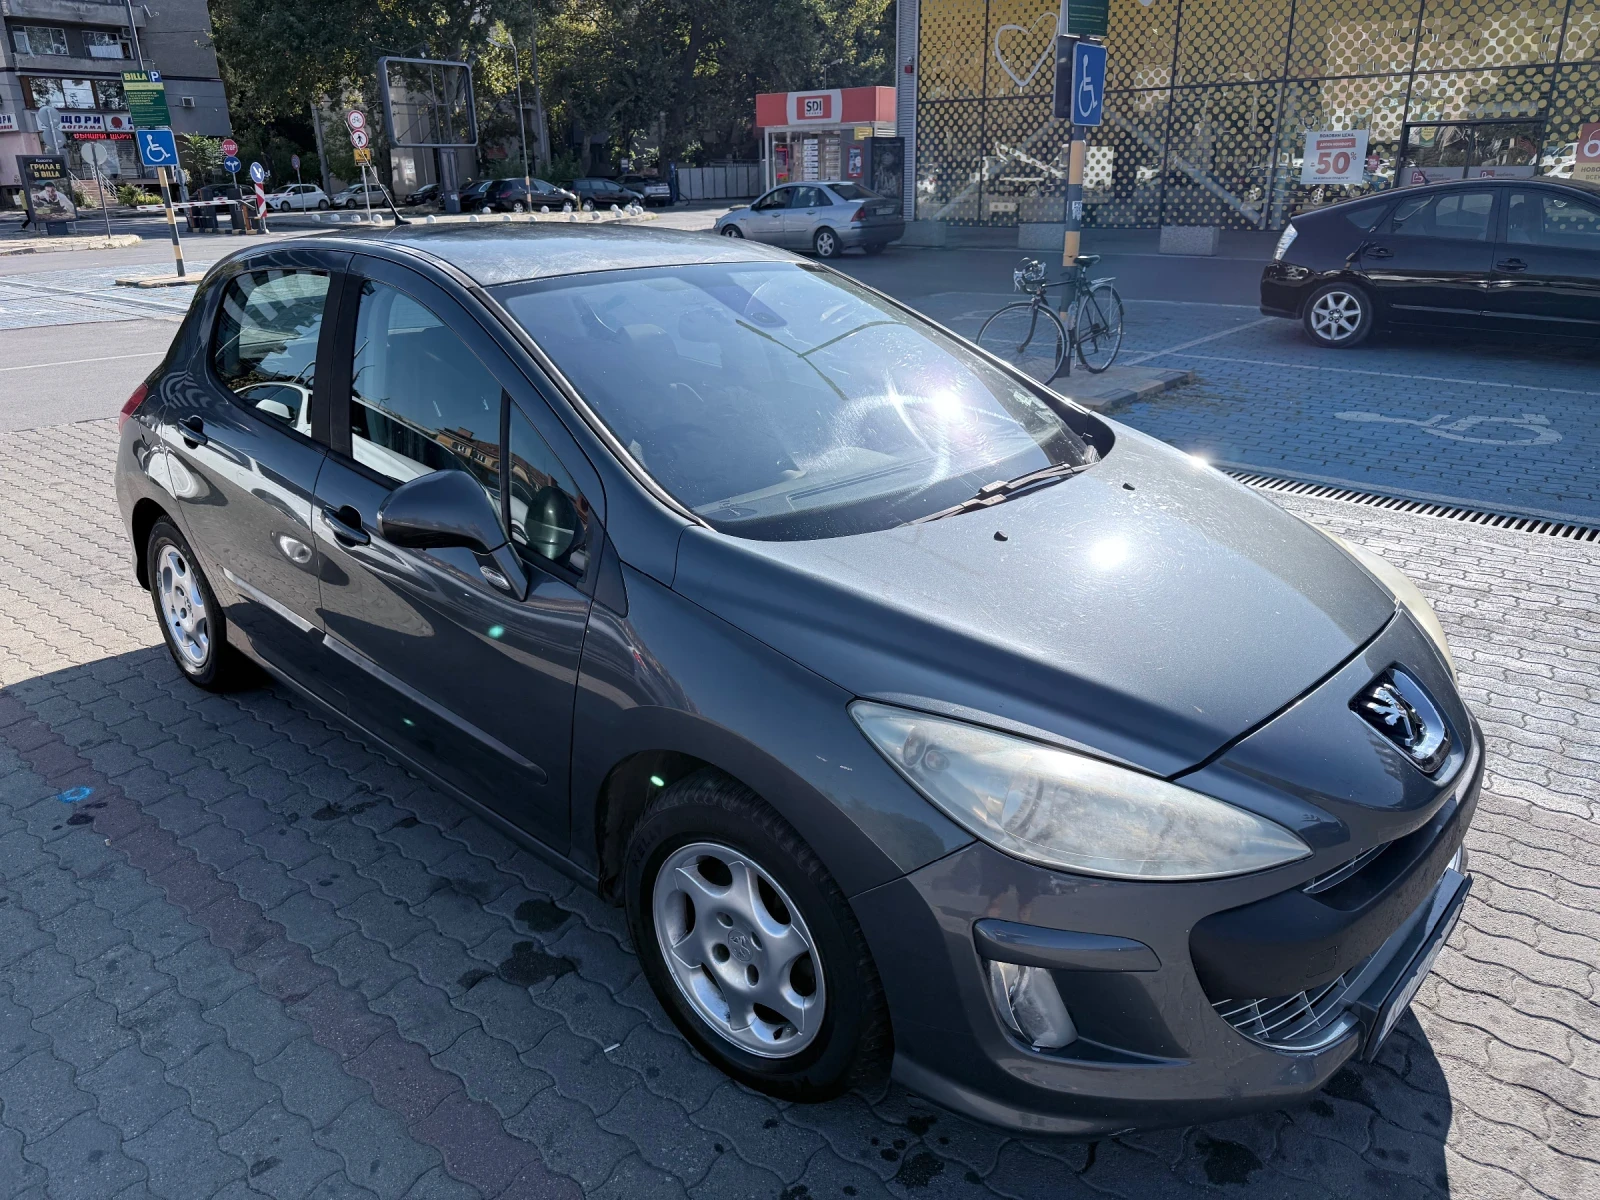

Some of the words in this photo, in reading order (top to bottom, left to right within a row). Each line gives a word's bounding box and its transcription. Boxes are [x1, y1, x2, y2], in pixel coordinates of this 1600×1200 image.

[123, 72, 148, 80] BILLA
[150, 71, 159, 81] P
[806, 101, 822, 112] SDI
[60, 115, 101, 124] ЩОРИ
